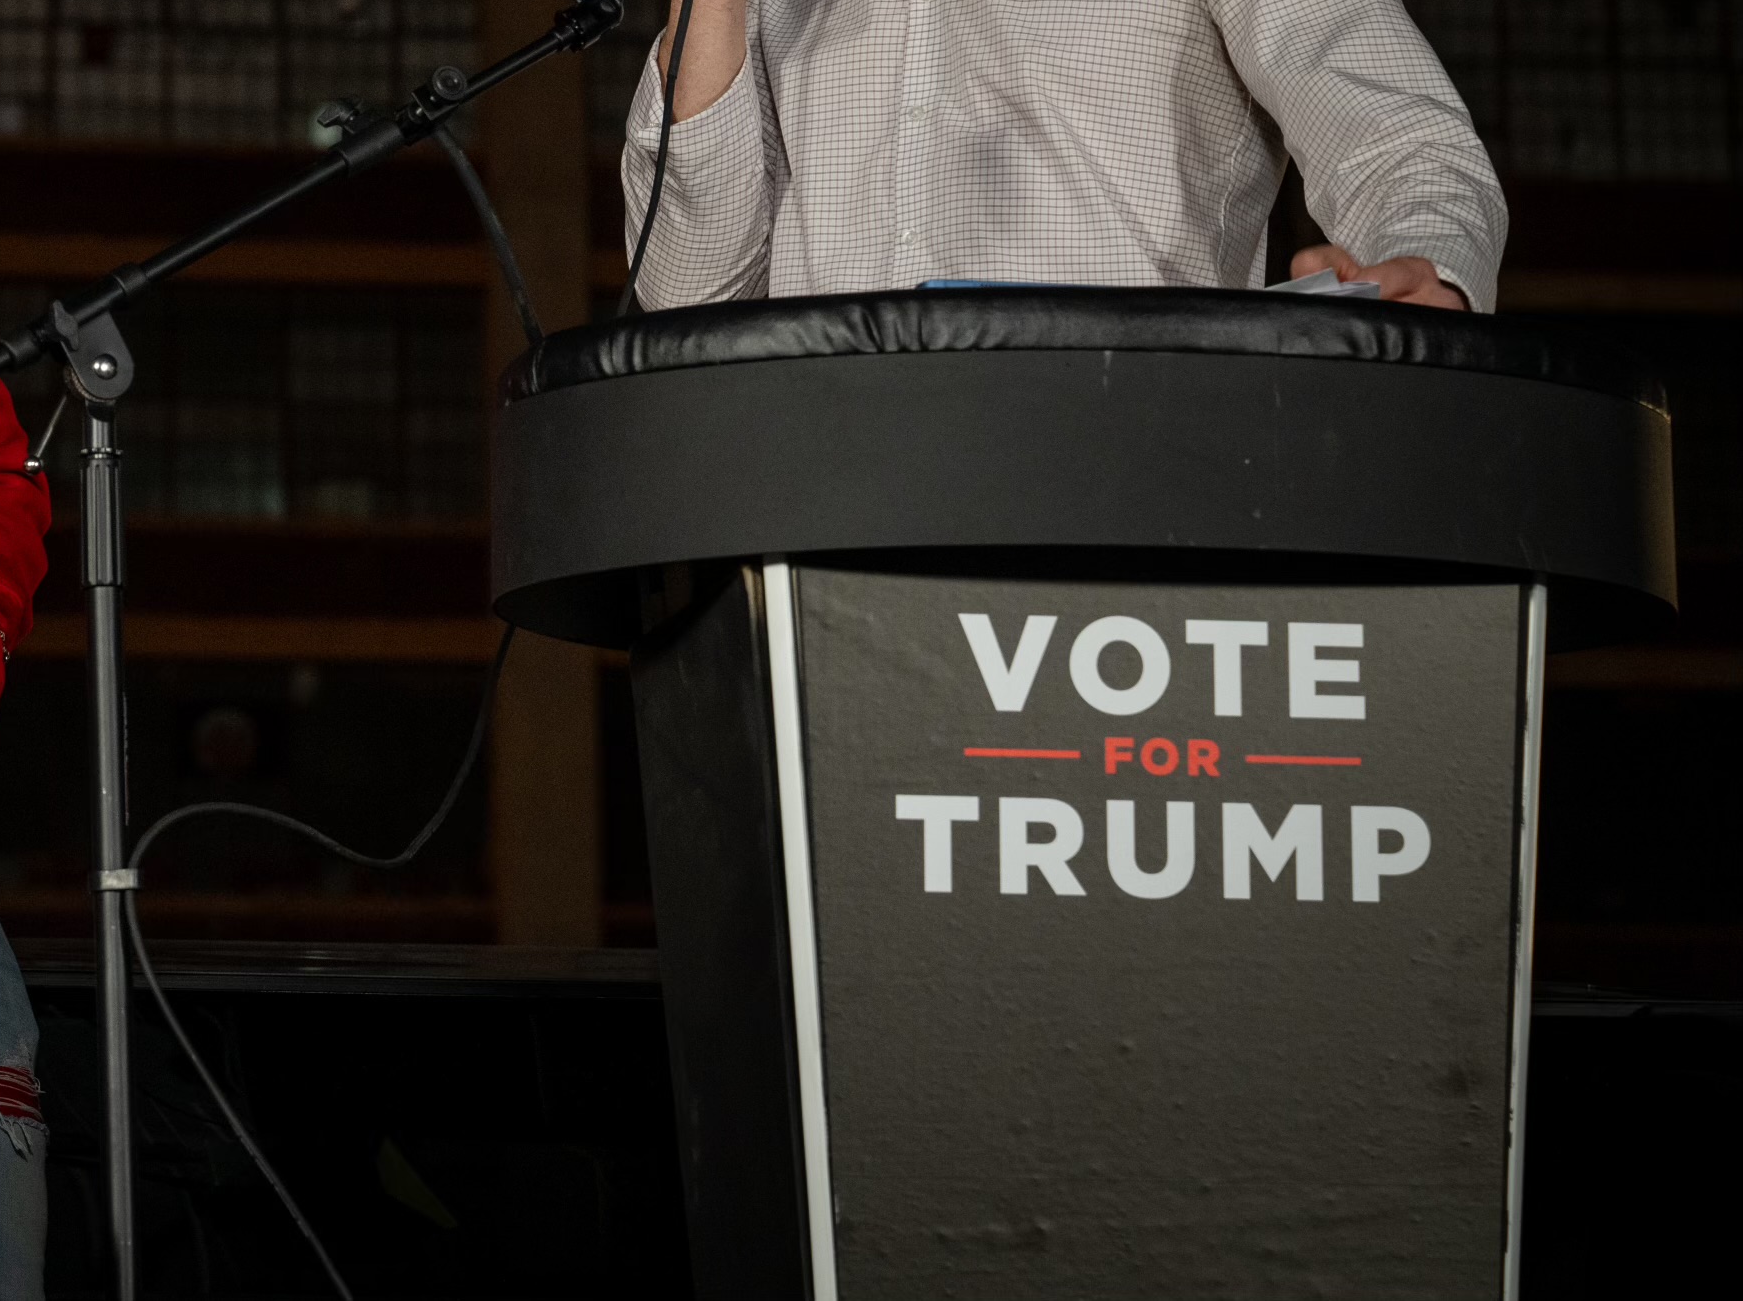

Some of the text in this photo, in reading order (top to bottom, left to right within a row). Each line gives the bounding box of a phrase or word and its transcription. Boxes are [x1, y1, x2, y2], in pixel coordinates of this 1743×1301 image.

[957, 612, 1367, 720] VOTE
[1103, 736, 1221, 777] FOR
[894, 793, 1432, 903] TRUMP
